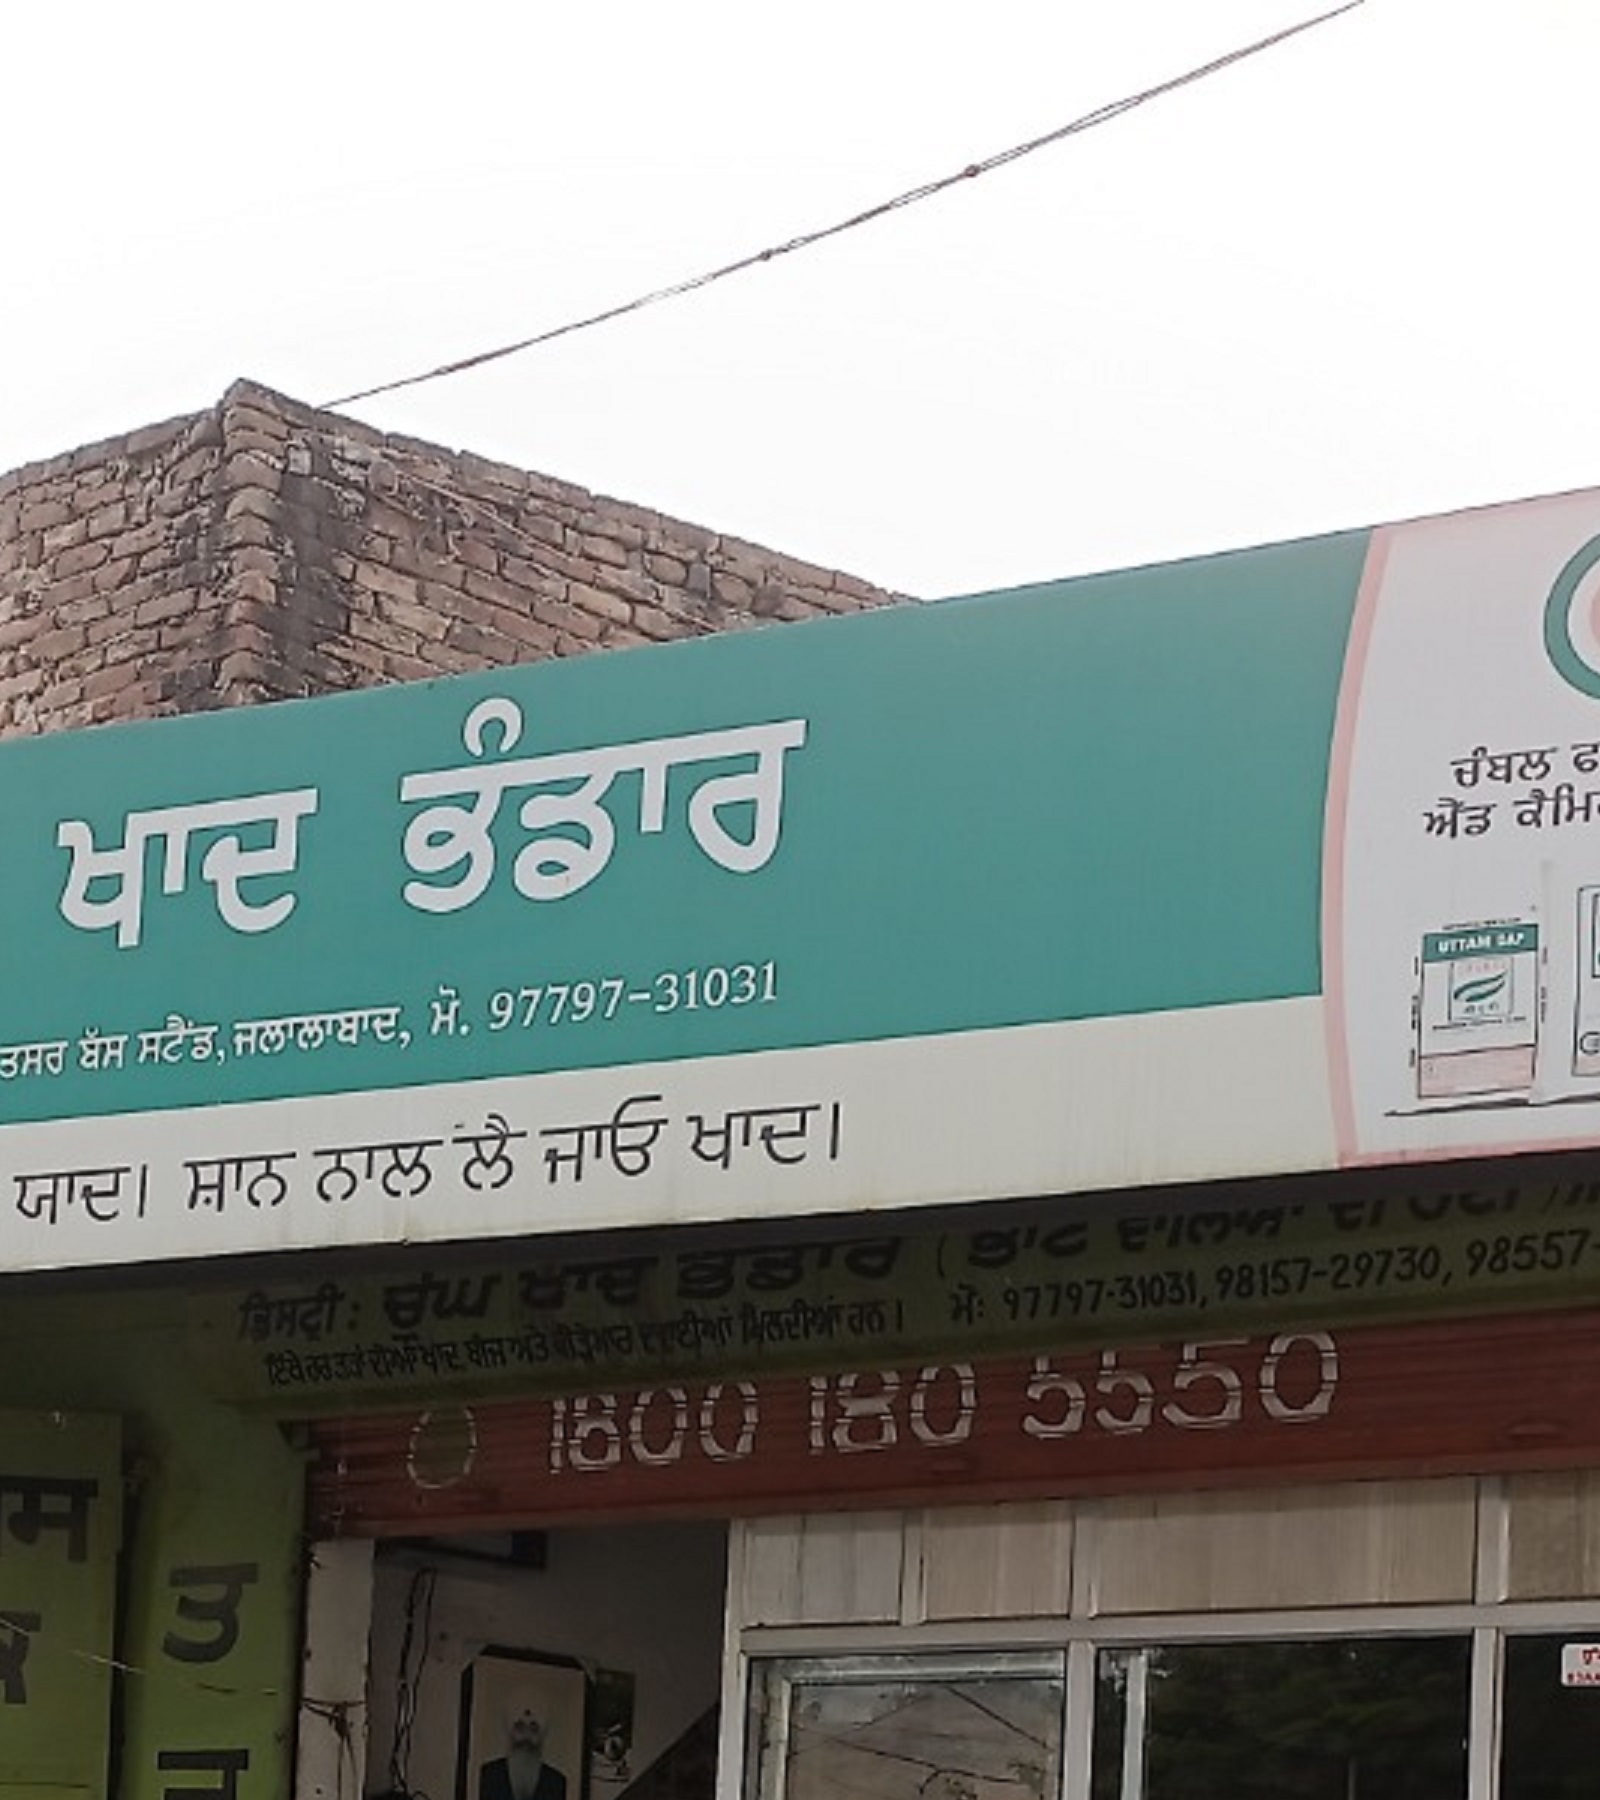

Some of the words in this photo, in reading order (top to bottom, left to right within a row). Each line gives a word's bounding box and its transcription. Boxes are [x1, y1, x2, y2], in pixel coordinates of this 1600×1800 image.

[57, 787, 319, 949] ਖਾਦ
[400, 697, 808, 914] ਭੰਡਾਰ
[1450, 746, 1558, 788] ਚੰਬਲ
[78, 1027, 130, 1071] ਬੱਸ
[233, 1005, 412, 1058] ਜਲਾਲਾਬਾਦ,
[430, 984, 471, 1036] ਮੋ.
[488, 960, 779, 1031] 97797-31031
[183, 1151, 297, 1212] ਸ਼ਾਨ
[312, 1139, 444, 1202] ਨਾਲ
[450, 1113, 528, 1191] ਲੈ
[539, 1093, 670, 1186] ਜਾਓ
[549, 1382, 760, 1475] 1800
[809, 1362, 976, 1455] 180
